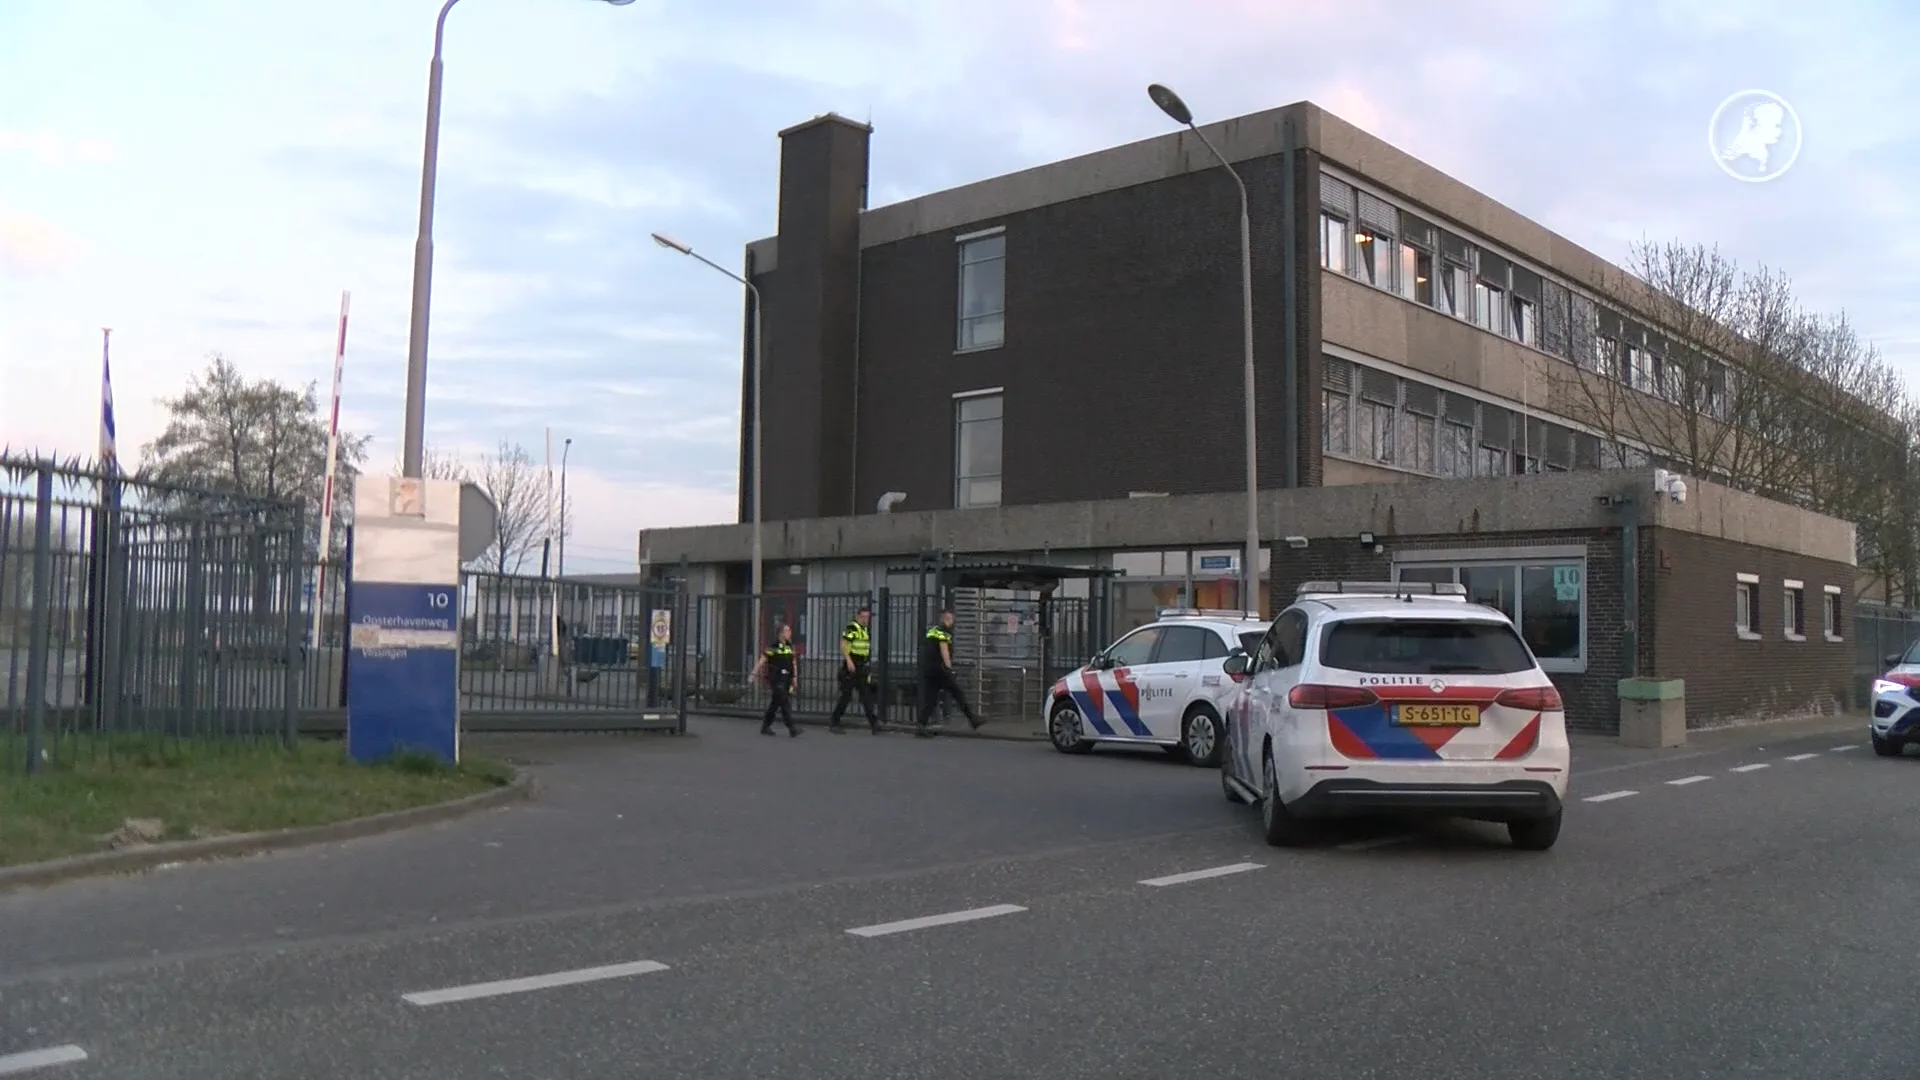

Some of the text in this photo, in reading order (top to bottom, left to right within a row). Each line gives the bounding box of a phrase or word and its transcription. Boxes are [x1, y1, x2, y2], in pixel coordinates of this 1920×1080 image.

[1558, 568, 1580, 585] 10
[428, 592, 449, 608] 10
[362, 614, 449, 629] Oosterhavenweg
[1359, 675, 1424, 686] POLITIE
[1405, 706, 1472, 721] S-651-TG
